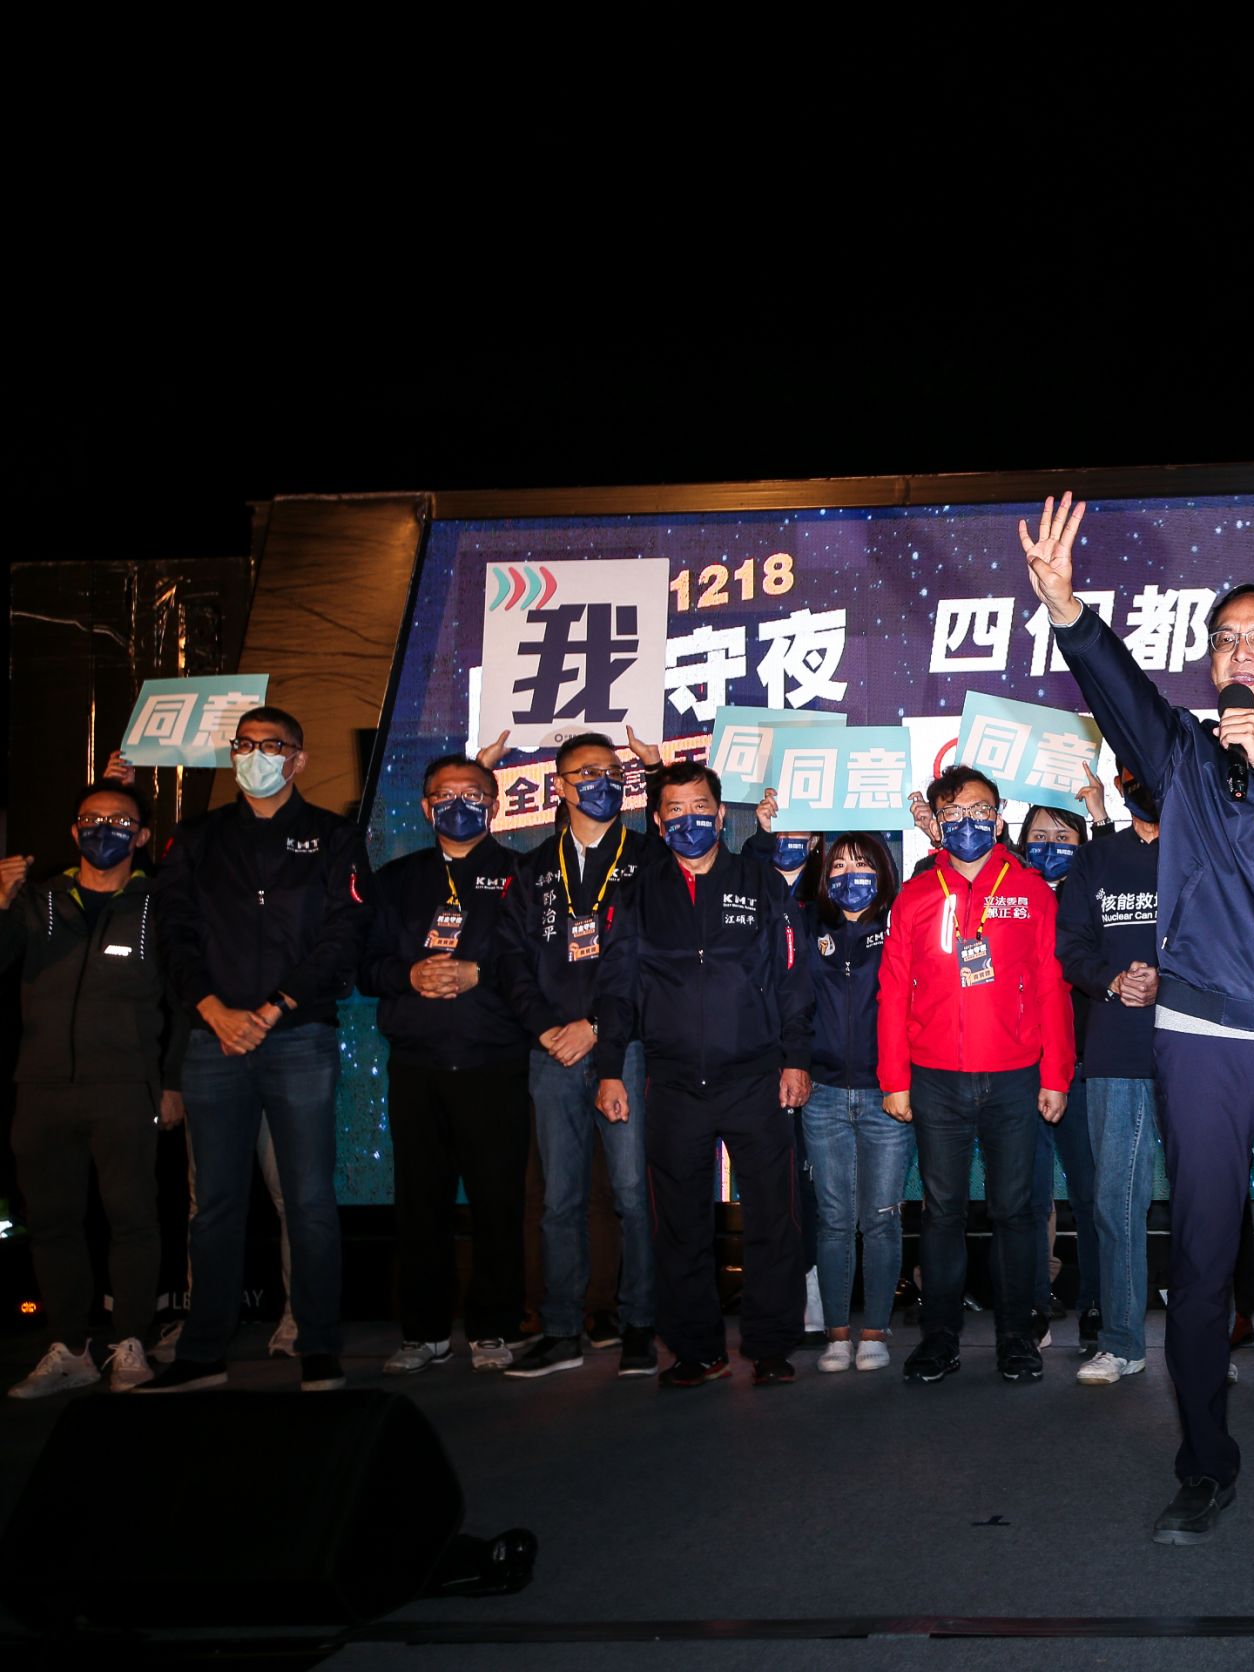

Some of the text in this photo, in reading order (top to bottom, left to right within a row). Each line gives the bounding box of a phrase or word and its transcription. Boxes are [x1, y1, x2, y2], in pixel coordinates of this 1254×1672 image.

[669, 553, 794, 612] 1218
[512, 603, 639, 725] 我
[127, 692, 260, 746] 同意
[712, 725, 774, 783] 同
[777, 748, 906, 809] 同意
[961, 714, 1097, 795] 同意
[723, 893, 757, 907] KMT
[1102, 911, 1153, 923] Nuclear Can
